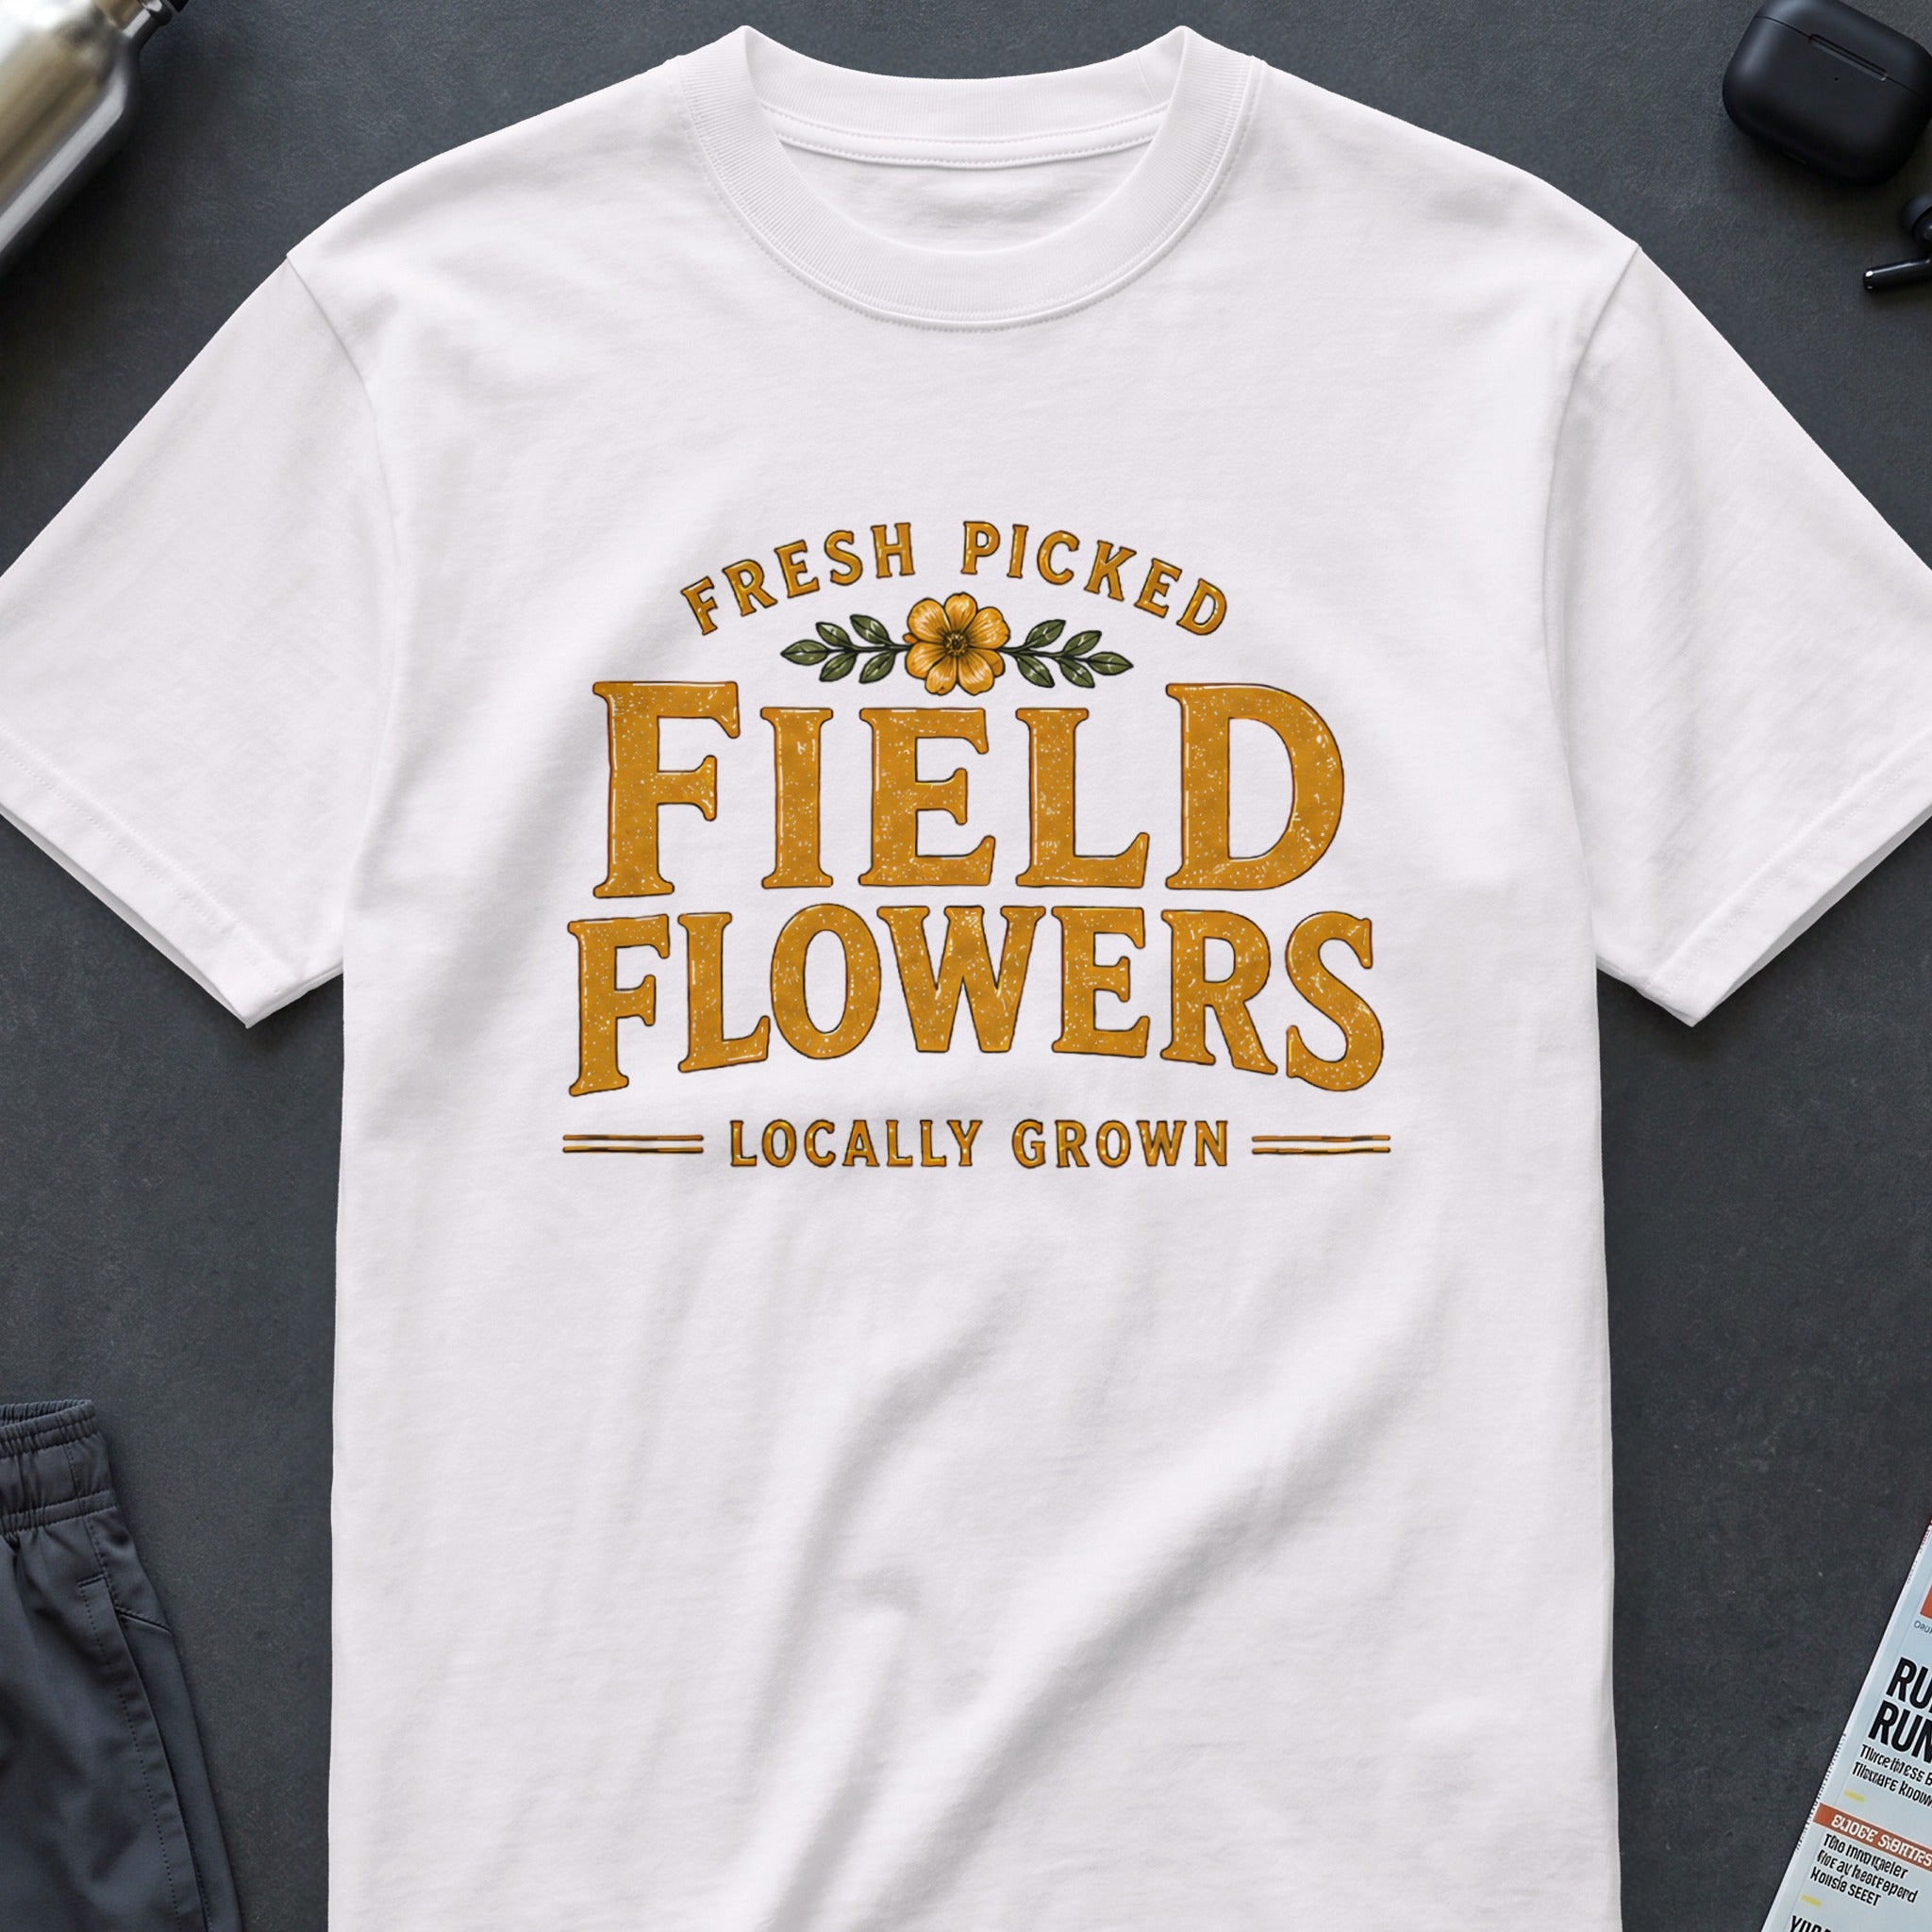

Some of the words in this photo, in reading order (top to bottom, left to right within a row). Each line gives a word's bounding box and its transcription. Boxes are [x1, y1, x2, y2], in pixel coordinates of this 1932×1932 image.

[681, 522, 915, 636] FRESH
[960, 521, 1227, 636] PICKED
[591, 681, 1344, 899] FIELD
[567, 903, 1385, 1097] FLOWERS
[729, 1119, 983, 1168] LOCALLY
[1011, 1118, 1228, 1169] GROWN
[1886, 1657, 1932, 1714] RU
